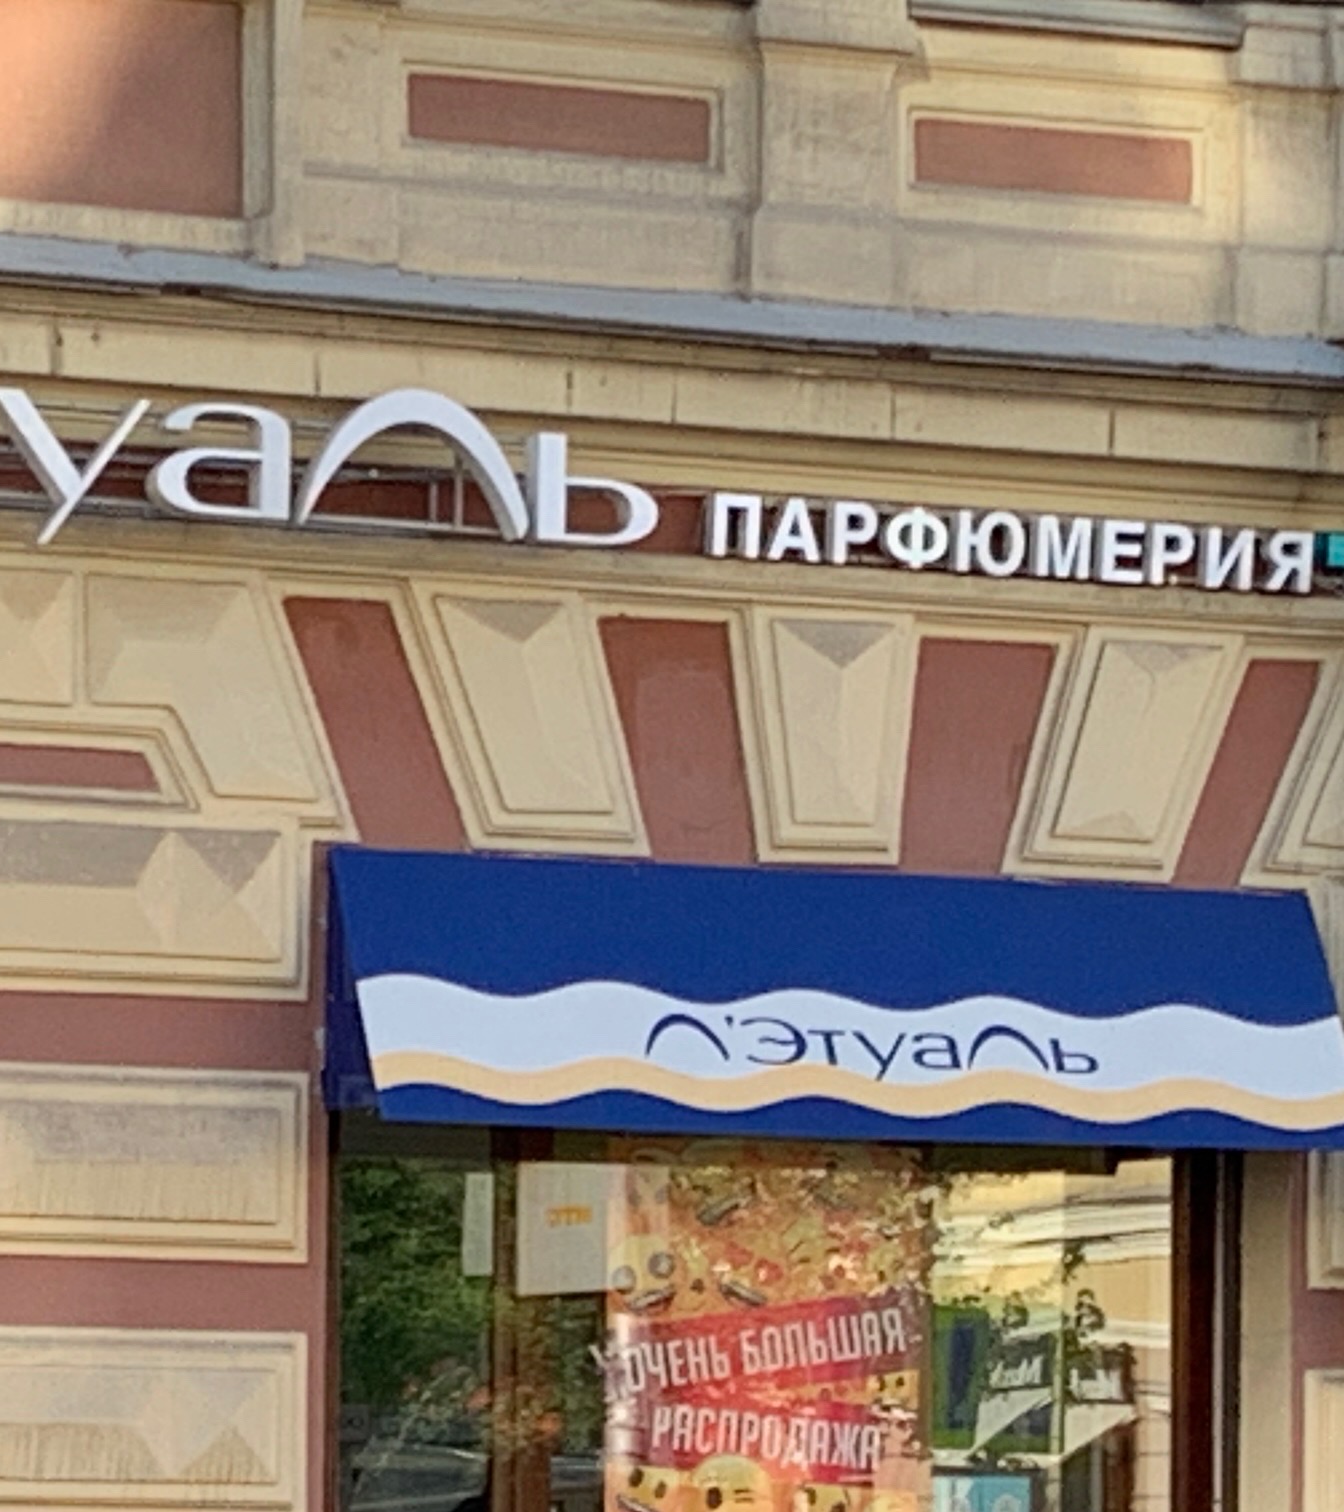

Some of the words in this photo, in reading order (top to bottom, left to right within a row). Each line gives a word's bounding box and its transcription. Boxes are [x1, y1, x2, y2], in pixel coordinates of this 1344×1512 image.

[710, 492, 1315, 594] ПАРФЮМЕРИЯ
[622, 1335, 732, 1394] ОЧЕНЬ
[739, 1307, 907, 1376] БОЛЬШАЯ
[651, 1403, 882, 1472] РАСПРОДАЖА
